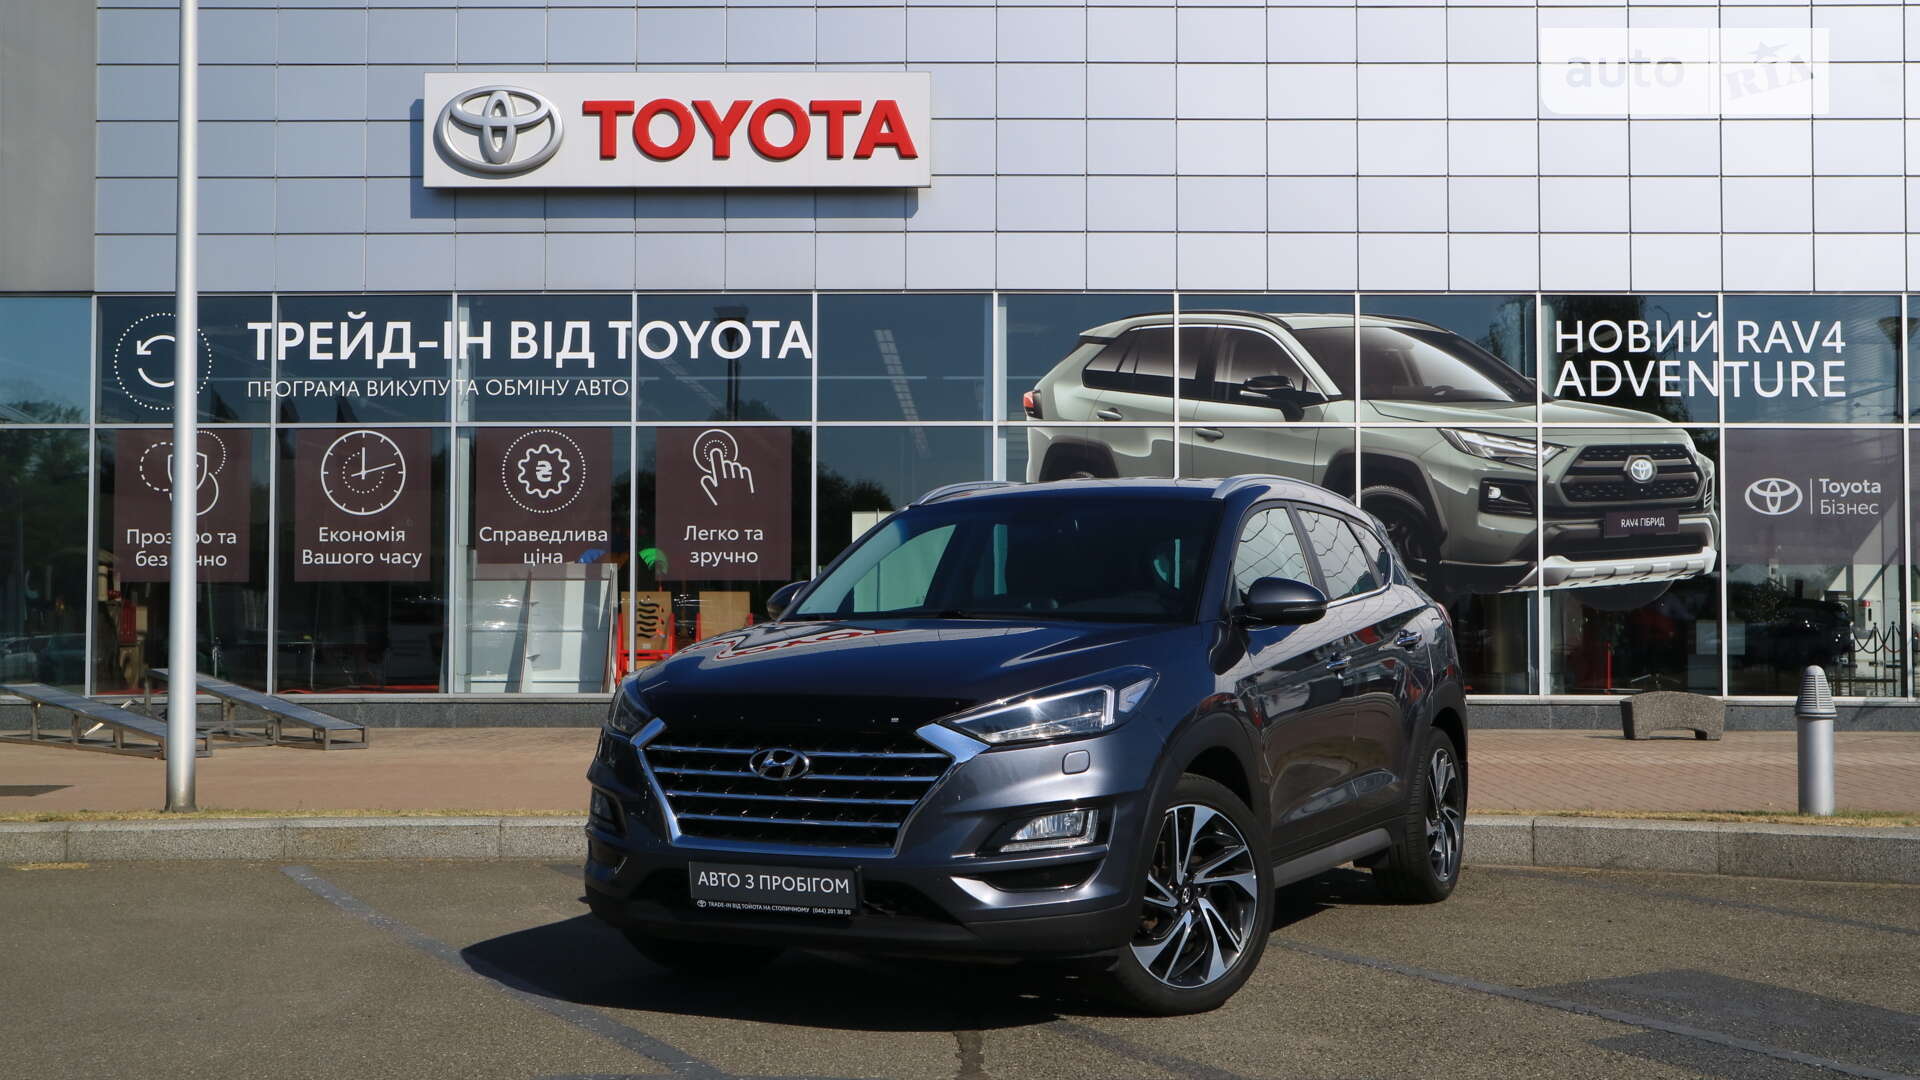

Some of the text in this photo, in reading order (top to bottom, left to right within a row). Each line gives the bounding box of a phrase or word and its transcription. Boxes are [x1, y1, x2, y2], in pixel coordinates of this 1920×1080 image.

[582, 98, 918, 161] TOYOTA
[248, 311, 813, 369] ТРЕЙД-ІН ВІД TOYOTA
[1555, 311, 1846, 353] НОВИЙ RAV4
[1553, 360, 1846, 397] ADVENTURE
[248, 379, 629, 398] ПРОГРАМА ВИКУПУ ТА ОБМІНУ АВТО
[1818, 478, 1882, 497] Toyota
[1819, 500, 1880, 515] Бізнес
[1620, 516, 1665, 528] RAV4 ГІБРИД
[217, 532, 237, 544] та
[319, 526, 405, 543] Економія
[479, 526, 608, 546] Справедлива
[683, 525, 764, 542] Легко та
[302, 549, 422, 569] Вашого часу
[523, 549, 563, 565] ціна
[689, 552, 758, 568] зручно
[698, 871, 849, 894] АВТО З ПРОБІГОМ
